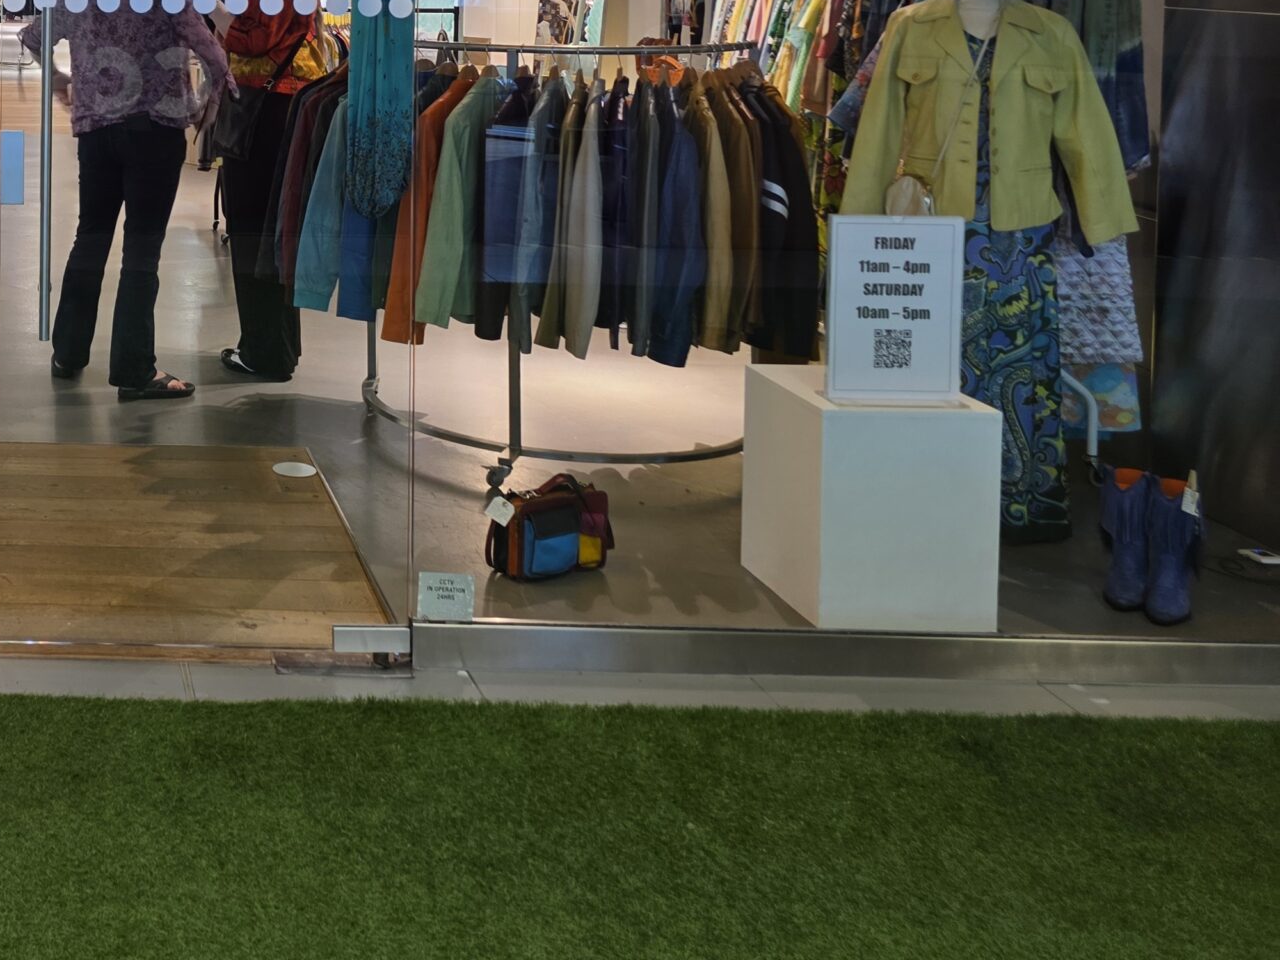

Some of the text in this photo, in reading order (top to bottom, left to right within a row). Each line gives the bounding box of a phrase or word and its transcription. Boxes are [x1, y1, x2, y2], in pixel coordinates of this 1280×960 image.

[874, 237, 916, 250] FRIDAY
[858, 260, 890, 273] 11am
[903, 260, 931, 274] 4pm
[863, 283, 924, 296] SATURDAY
[856, 306, 890, 319] 10am
[902, 306, 931, 320] 5pm
